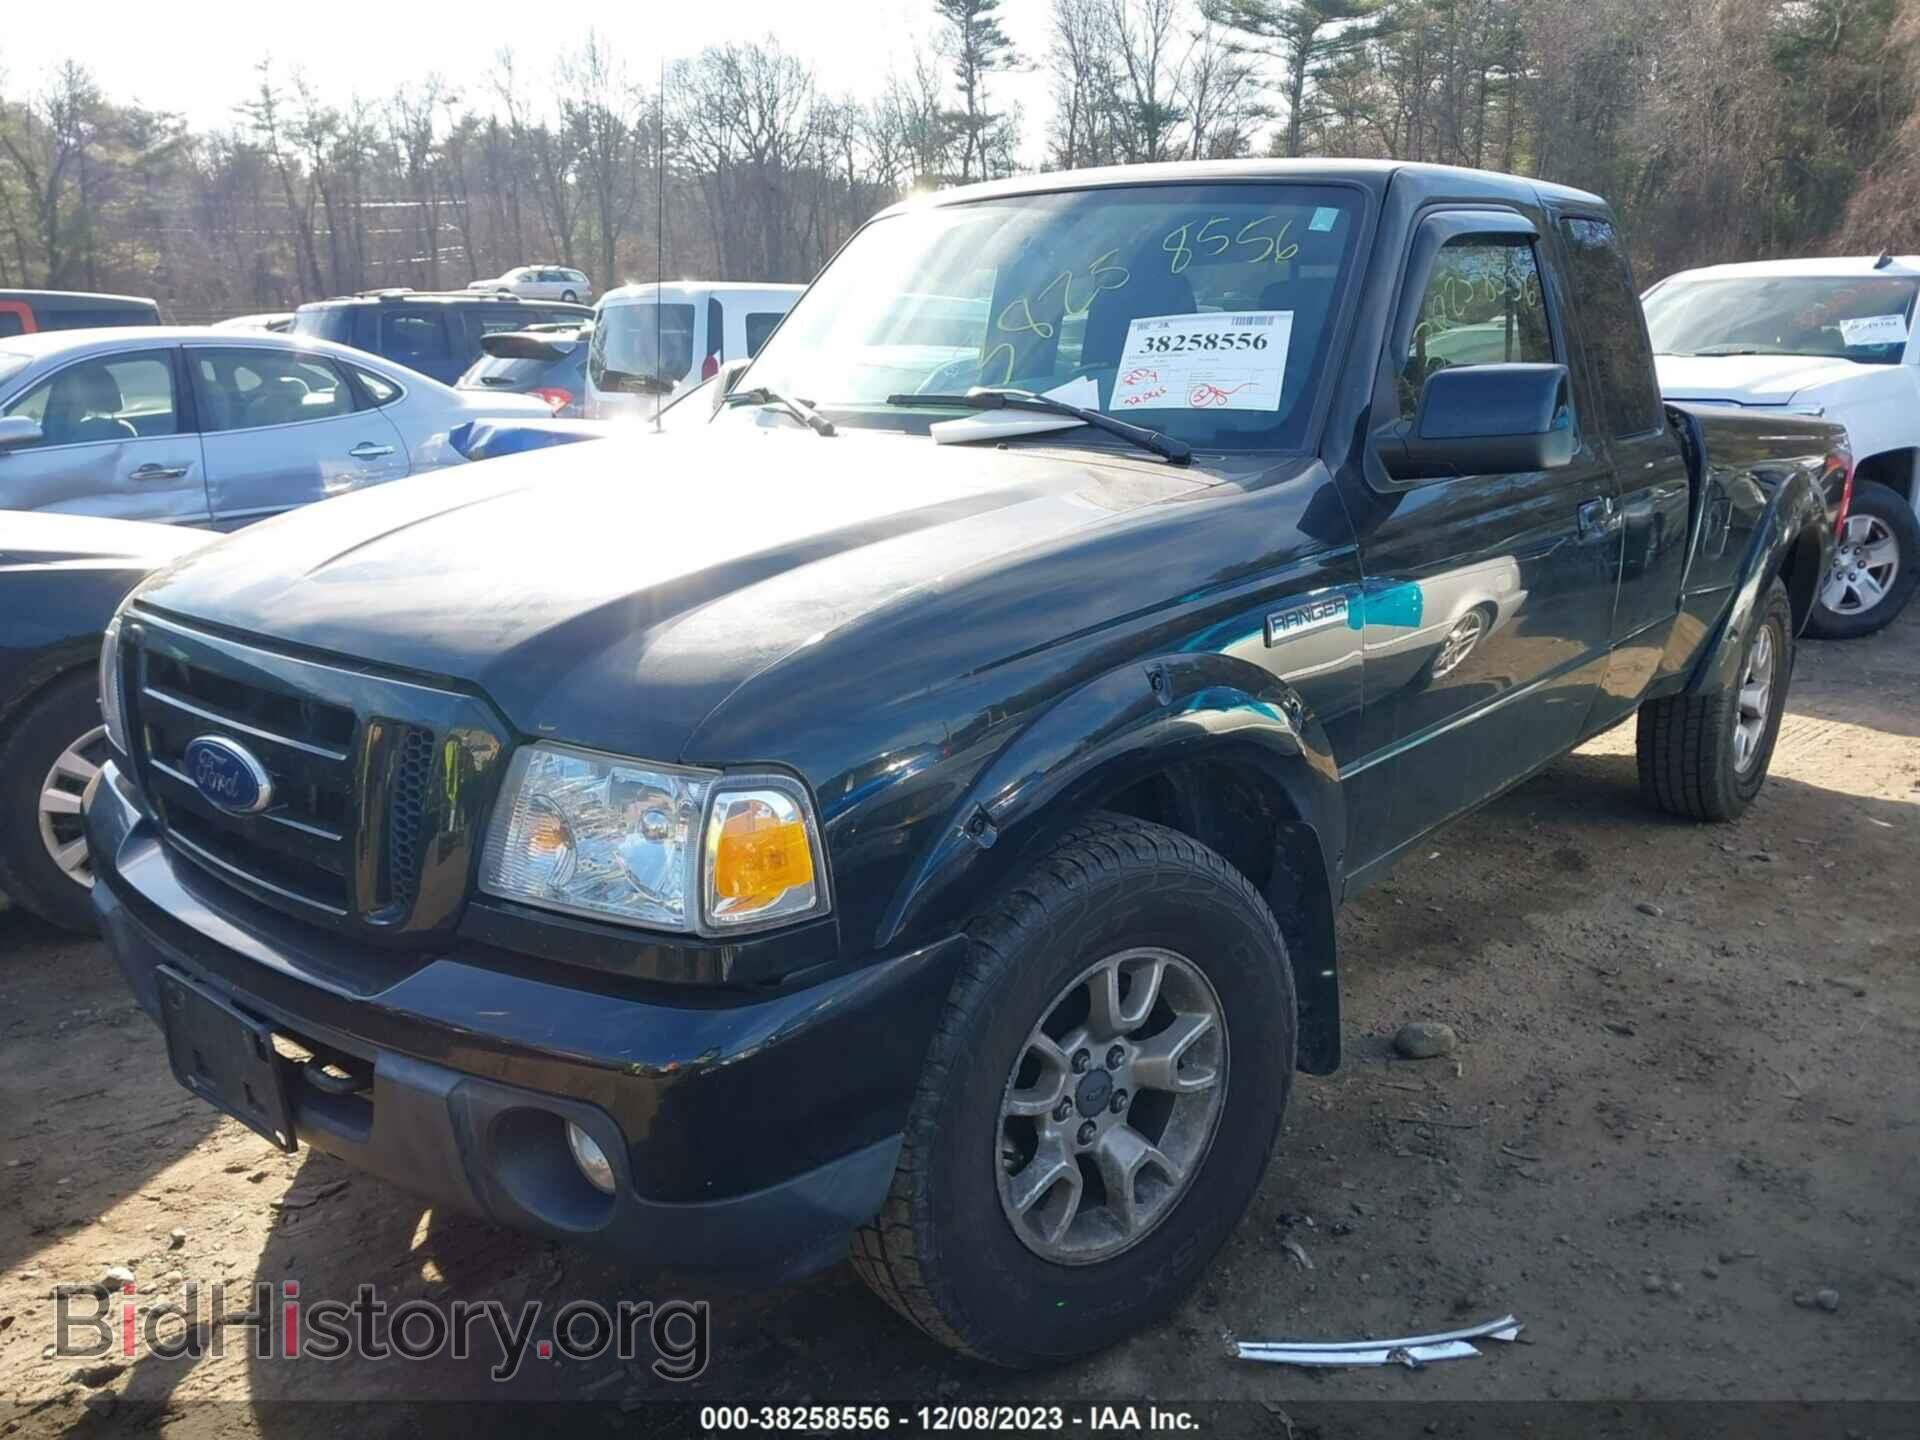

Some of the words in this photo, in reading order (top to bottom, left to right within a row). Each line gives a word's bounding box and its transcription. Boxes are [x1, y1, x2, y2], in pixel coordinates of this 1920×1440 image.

[1162, 215, 1299, 274] 8556
[1139, 332, 1269, 354] 38258556
[1270, 599, 1348, 633] RANGER
[195, 748, 241, 798] Ford
